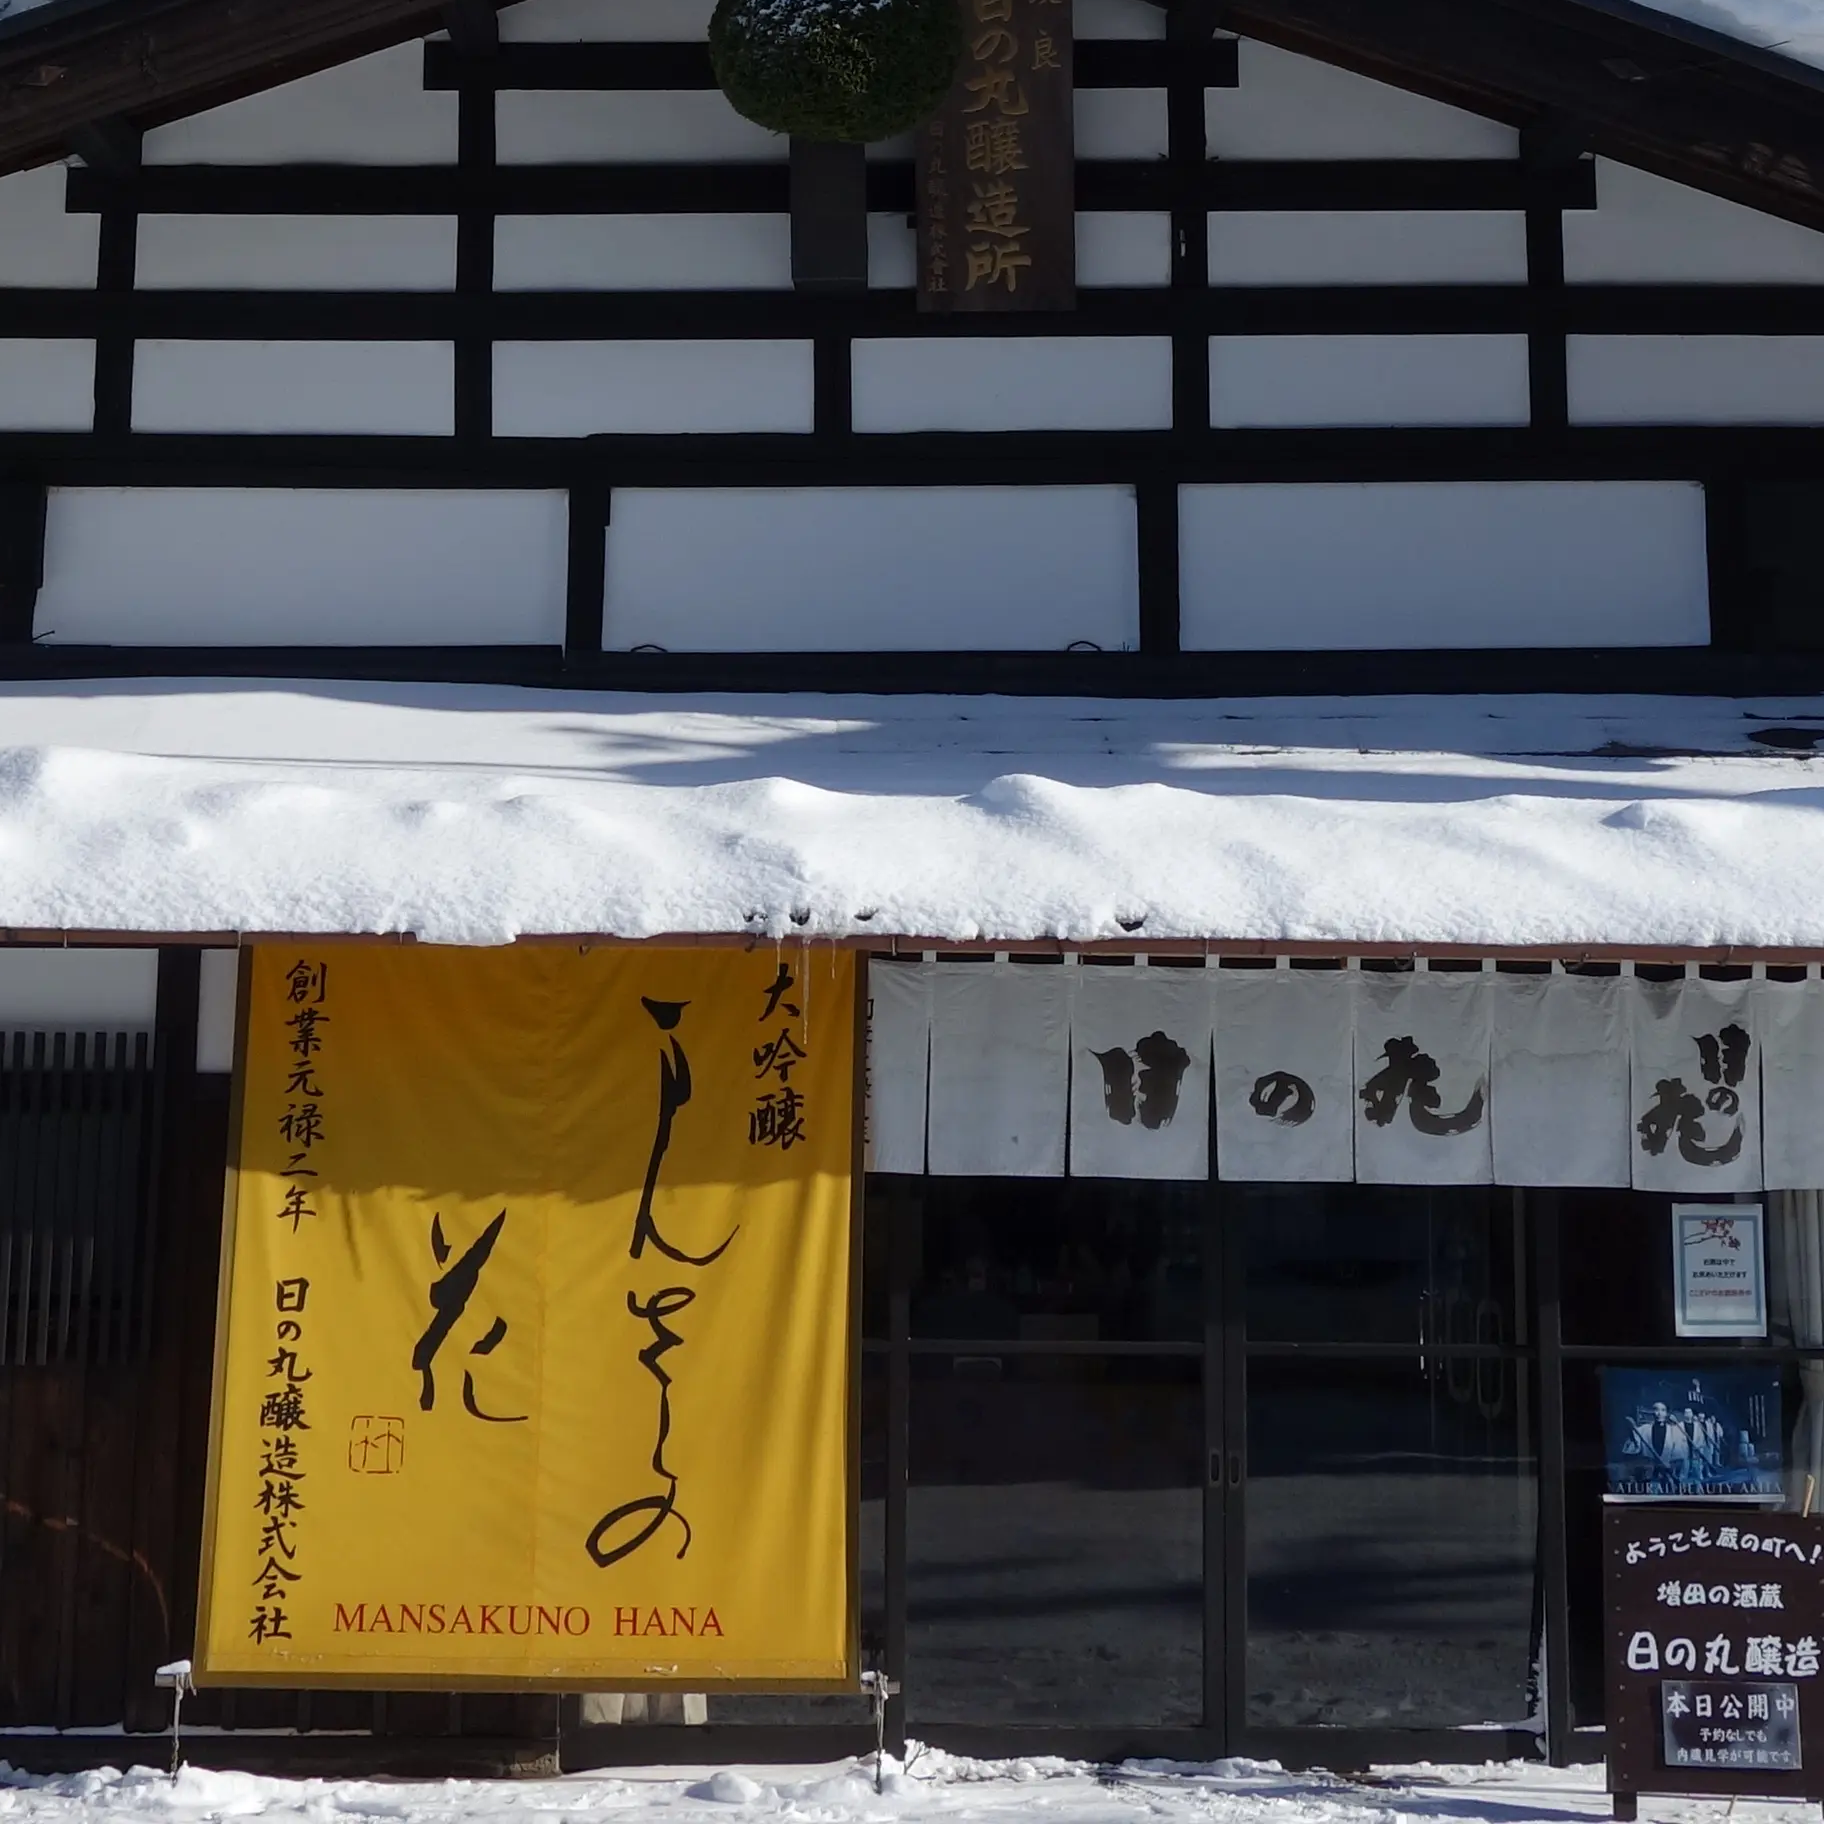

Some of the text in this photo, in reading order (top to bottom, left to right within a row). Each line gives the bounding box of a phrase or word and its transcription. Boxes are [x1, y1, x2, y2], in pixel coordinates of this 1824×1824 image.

[749, 962, 808, 1151] 大吟醸
[248, 959, 331, 1646] 創業元禄二年 日の丸醸造株式会社
[411, 1207, 530, 1423] 花
[1656, 1580, 1785, 1609] 増田の酒蔵
[332, 1602, 725, 1638] MANSAKUNO HANA
[1627, 1631, 1821, 1678] 日の丸醸造
[1666, 1691, 1795, 1721] 本日公開中
[1699, 1727, 1768, 1743] 予約なしでも
